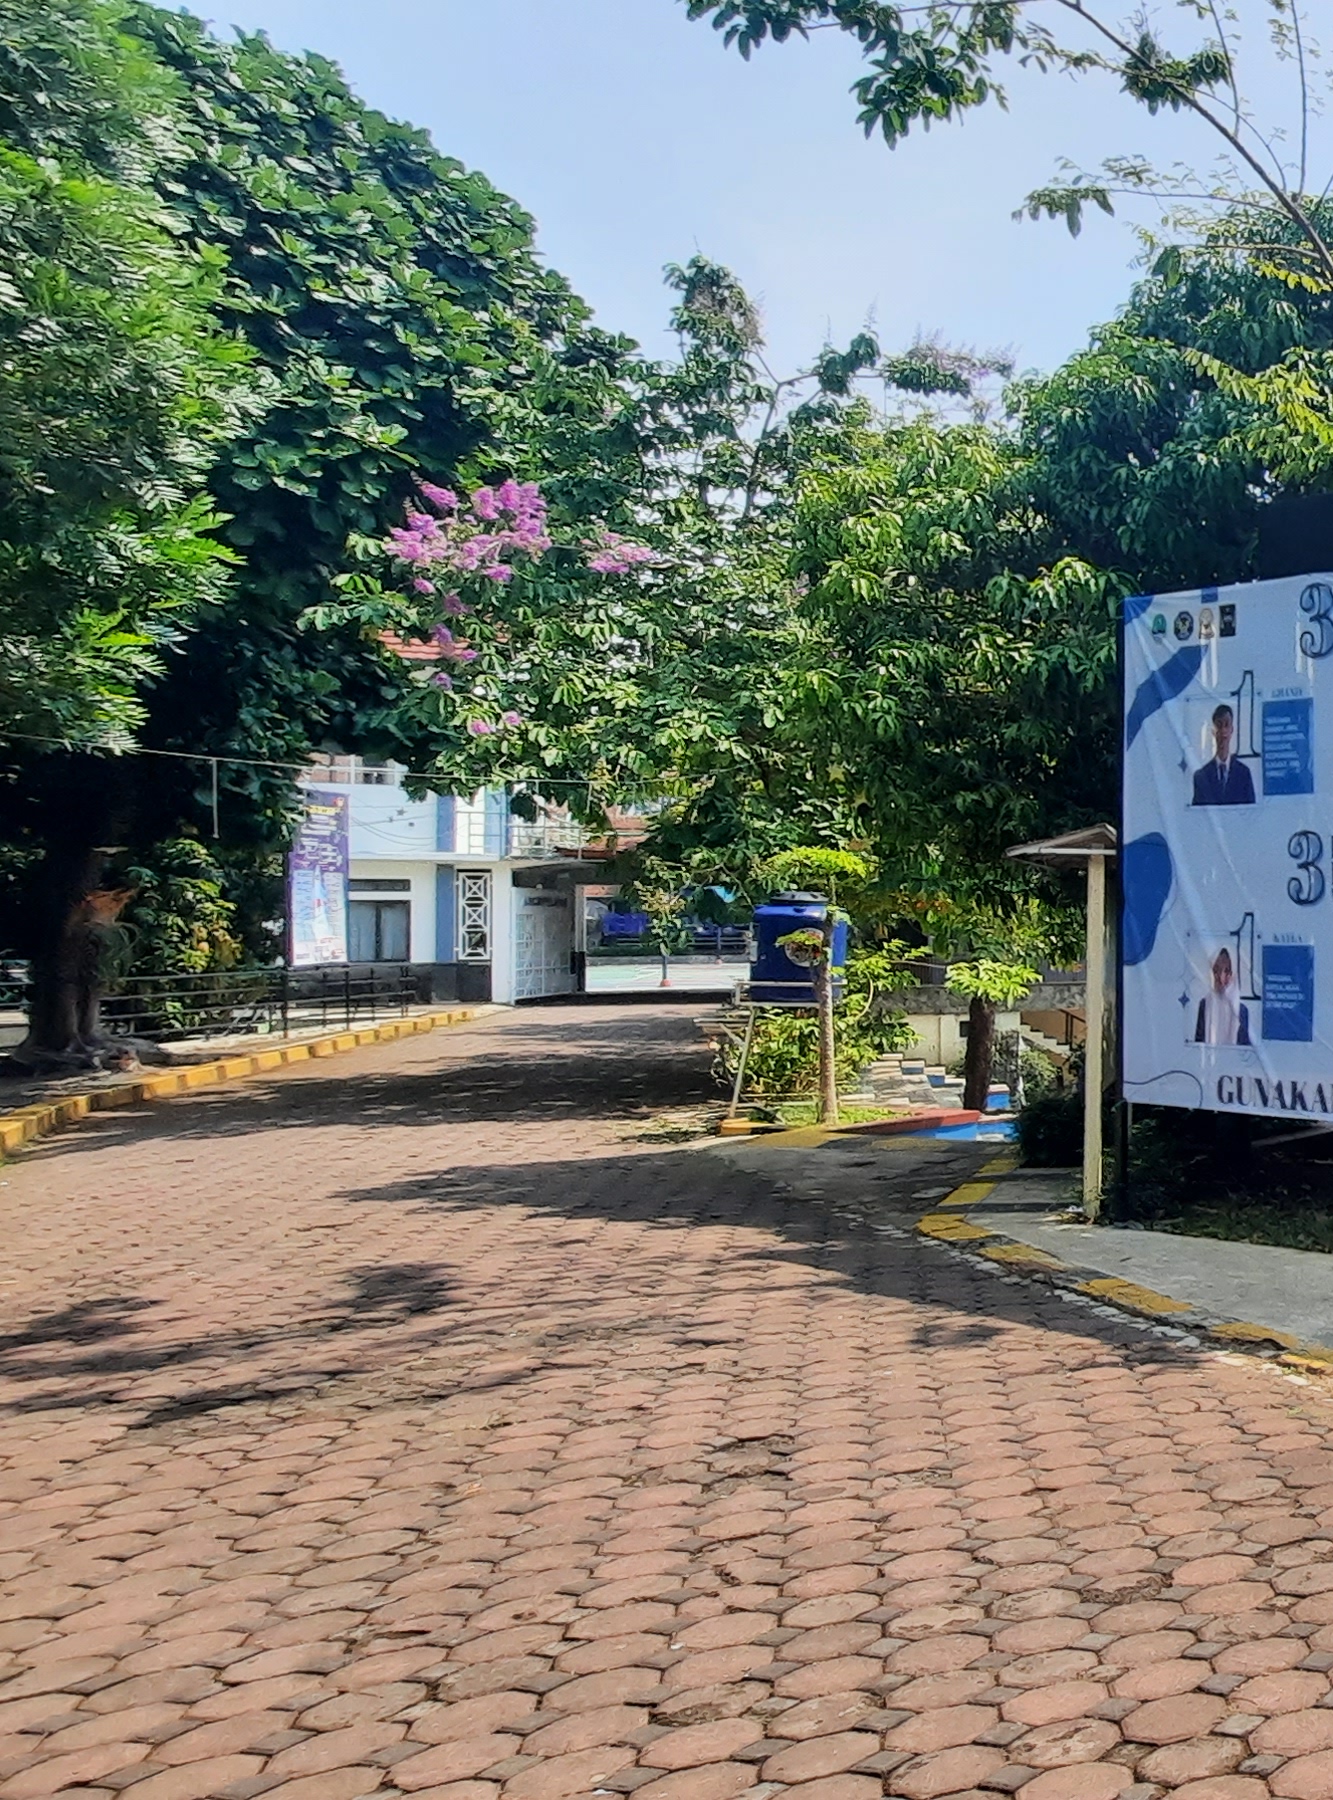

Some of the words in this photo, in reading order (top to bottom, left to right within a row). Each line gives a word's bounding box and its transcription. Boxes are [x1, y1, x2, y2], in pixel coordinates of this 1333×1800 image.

[1230, 670, 1261, 758] 1
[1287, 830, 1325, 905] 3
[1230, 911, 1261, 1000] 1
